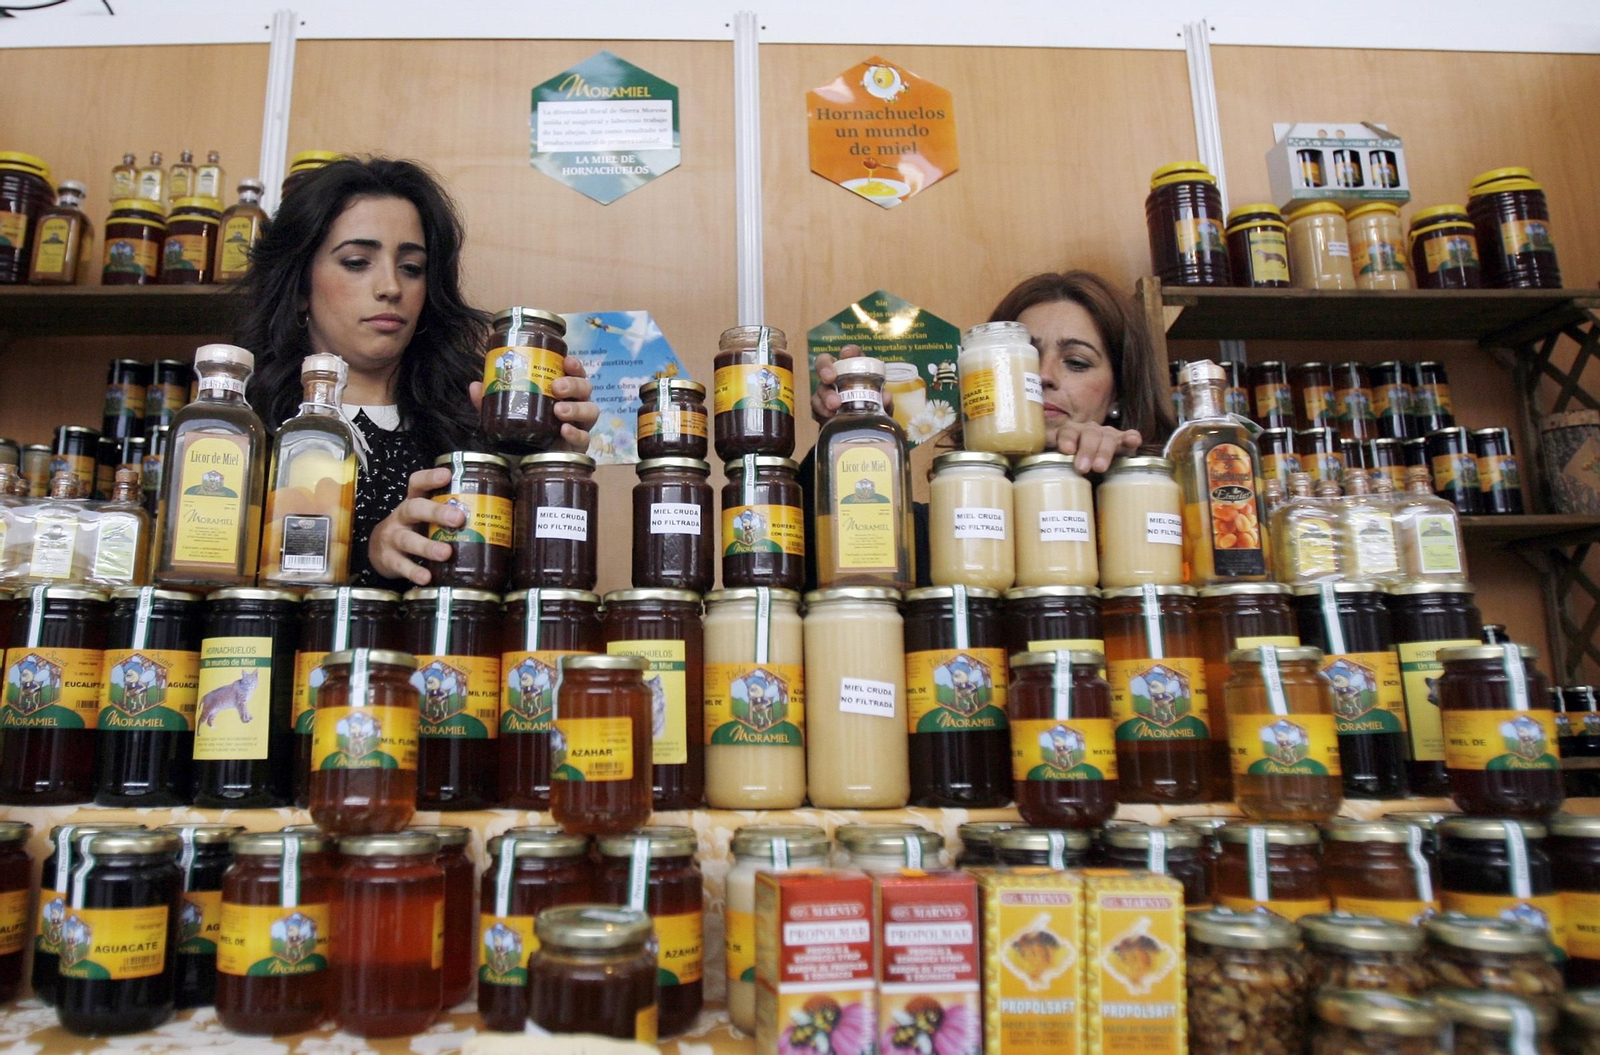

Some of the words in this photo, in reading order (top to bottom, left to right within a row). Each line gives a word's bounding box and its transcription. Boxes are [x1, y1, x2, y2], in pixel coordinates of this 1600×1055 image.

[559, 74, 651, 98] MORAMIEL
[817, 106, 945, 120] Hornachuelos
[643, 117, 668, 125] trabajo
[835, 127, 858, 138] un
[865, 124, 930, 138] mundo
[850, 142, 871, 155] de
[877, 141, 918, 155] miel
[576, 156, 589, 164] LA
[595, 155, 618, 164] MIEL
[621, 155, 635, 163] DE
[562, 165, 649, 176] HORNACHUELOS
[875, 299, 888, 307] Sin
[841, 322, 854, 330] hay
[874, 344, 906, 353] vegetales
[597, 359, 644, 367] constituyen
[606, 383, 616, 391] de
[596, 394, 638, 403] encargada
[616, 406, 627, 414] de
[190, 449, 210, 464] Licor
[212, 451, 221, 465] de
[222, 452, 239, 466] Miel
[841, 460, 860, 473] Licor
[861, 460, 871, 472] de
[871, 460, 887, 472] Miel
[183, 508, 234, 526] MORAMIEL
[560, 512, 586, 521] CRUDA
[673, 508, 699, 516] CRUDA
[977, 513, 1003, 521] CRUDA
[550, 524, 586, 533] FILTRADA
[664, 519, 700, 528] FILTRADA
[842, 516, 890, 531] MORAMIEL
[968, 524, 1004, 532] FILTRADA
[844, 683, 864, 693] MIEL
[866, 686, 892, 696] CRUDA
[841, 696, 853, 704] NO
[855, 697, 893, 709] FILTRADA
[4, 709, 59, 727] MORAMIEL
[106, 709, 165, 728] MORAMIEL
[936, 712, 996, 729] MORAMIEL
[729, 724, 790, 744] MORAMIEL
[1133, 721, 1196, 739] MORAMIEL
[1472, 738, 1487, 747] DE
[571, 748, 613, 758] AZAHAR
[333, 754, 381, 767] MORAMIEL
[1263, 761, 1313, 775] MORAMIEL
[811, 905, 859, 917] MARNYS
[913, 905, 962, 918] MARNYS
[789, 926, 867, 943] PROPOLMAR
[891, 928, 970, 944] PROPOLMAR
[94, 941, 158, 954] AGUACATE
[234, 937, 246, 947] DE
[267, 961, 317, 975] MORAMIEL
[1001, 1000, 1075, 1015] PROPOLSAFT
[1103, 1004, 1176, 1019] PROPOLSAFT
